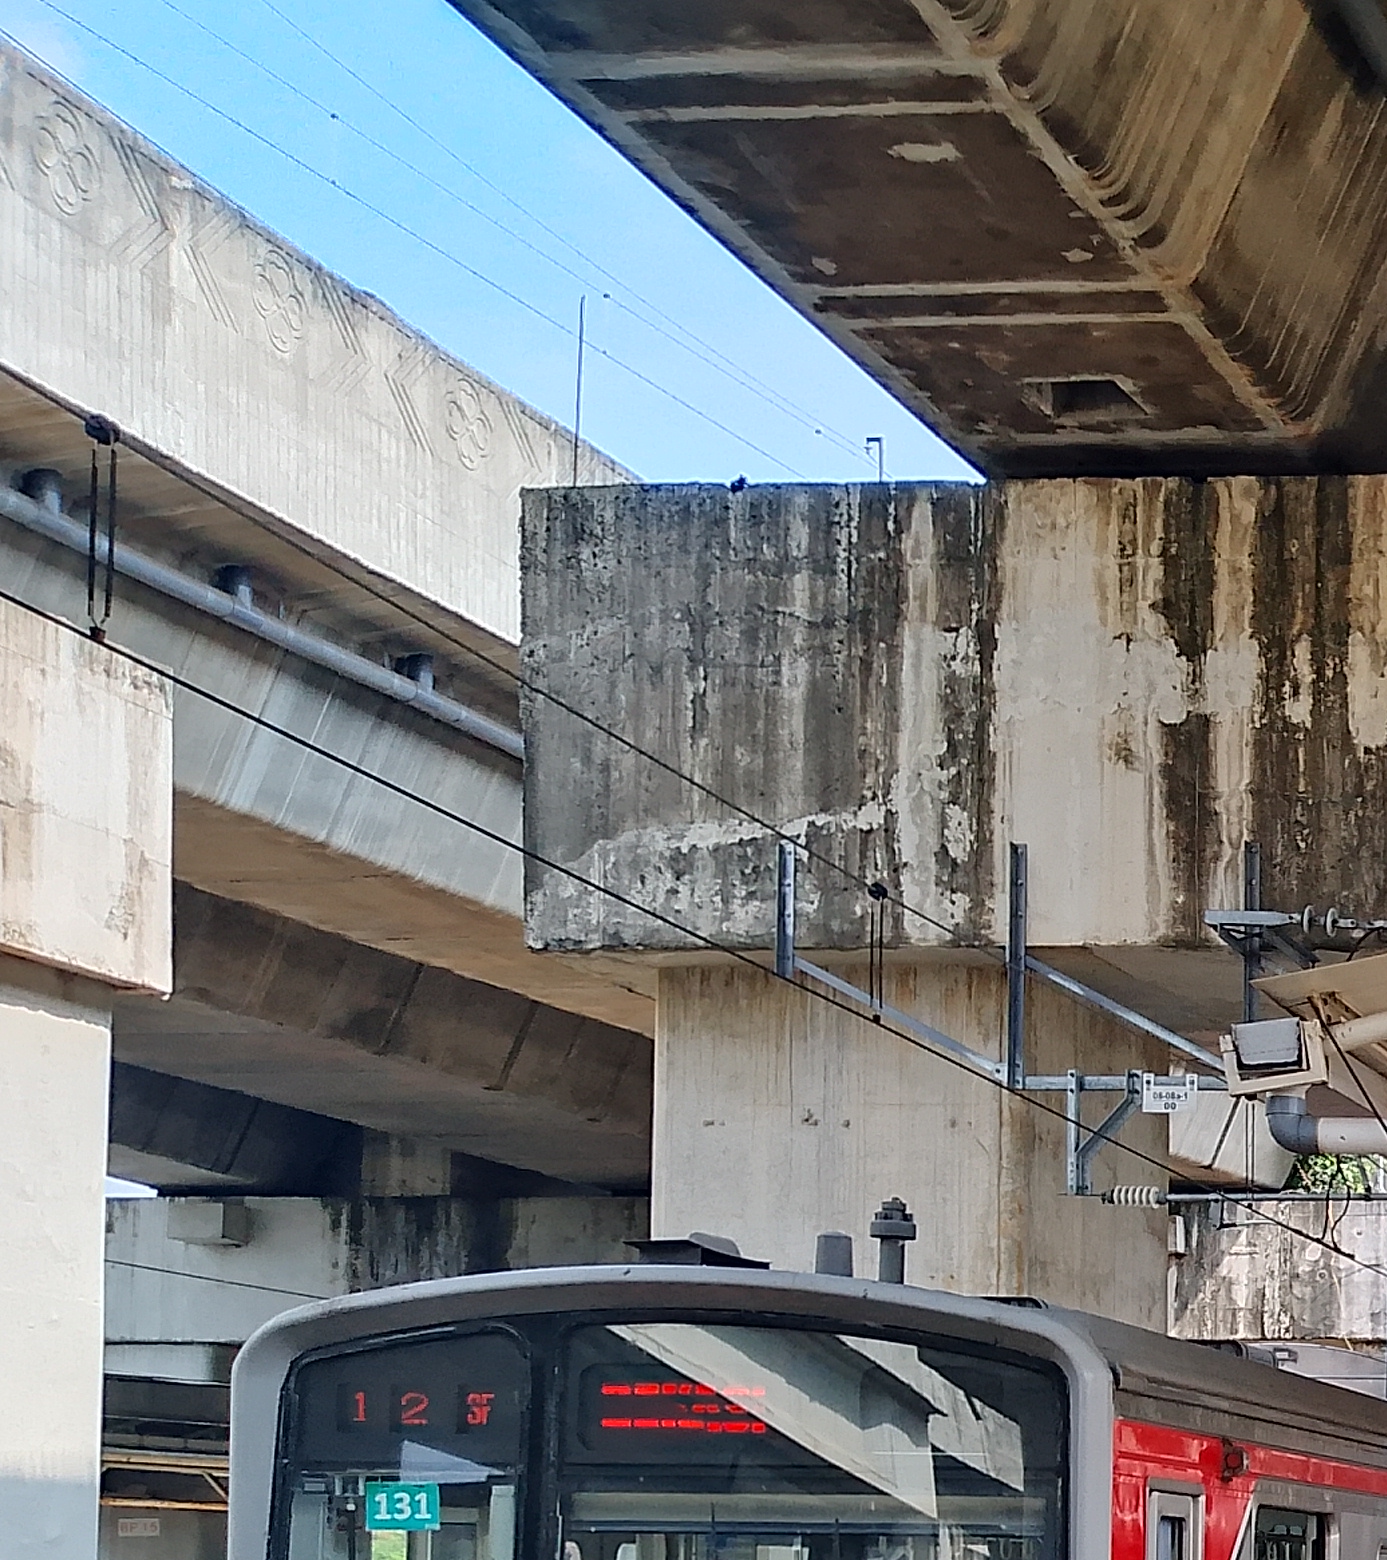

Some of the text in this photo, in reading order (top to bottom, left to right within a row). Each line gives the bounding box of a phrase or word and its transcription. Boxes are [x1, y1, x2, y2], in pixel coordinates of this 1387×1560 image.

[1163, 1101, 1177, 1110] 00
[401, 1391, 429, 1425] 2
[374, 1491, 432, 1520] 131
